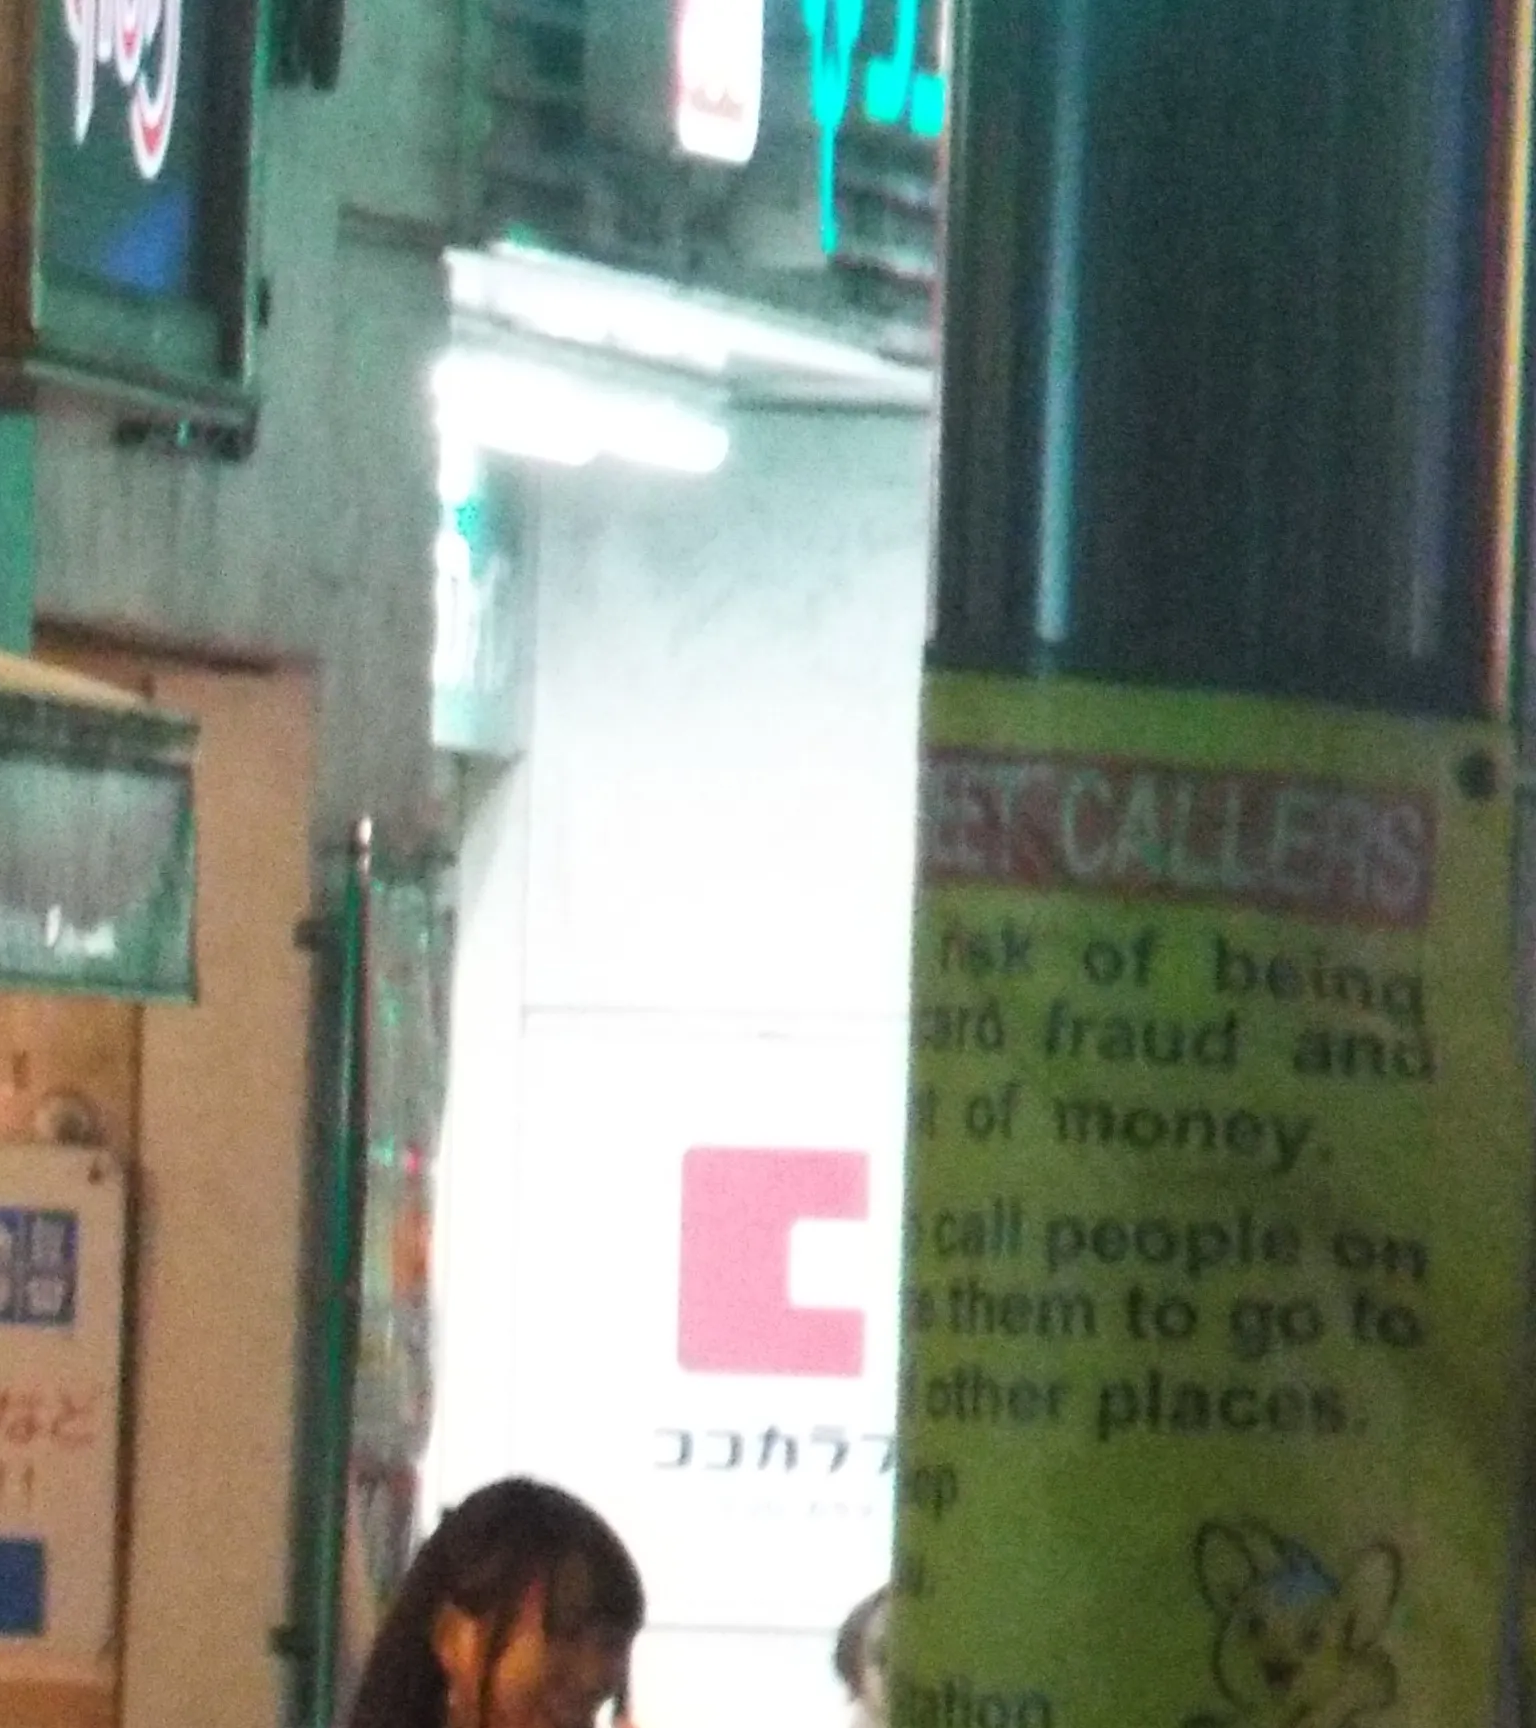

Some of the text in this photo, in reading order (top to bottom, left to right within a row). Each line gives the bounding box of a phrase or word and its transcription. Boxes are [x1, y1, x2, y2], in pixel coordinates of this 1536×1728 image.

[1060, 768, 1430, 914] CALLERS
[1082, 924, 1157, 988] of
[1213, 933, 1426, 1026] being
[1044, 1002, 1240, 1071] fraud
[1292, 1027, 1436, 1082] and
[963, 1084, 1022, 1141] of
[933, 1199, 1428, 1283] call people on
[948, 1281, 1097, 1338] them
[1127, 1287, 1198, 1341] to
[1230, 1300, 1324, 1362] go
[1351, 1293, 1426, 1349] to
